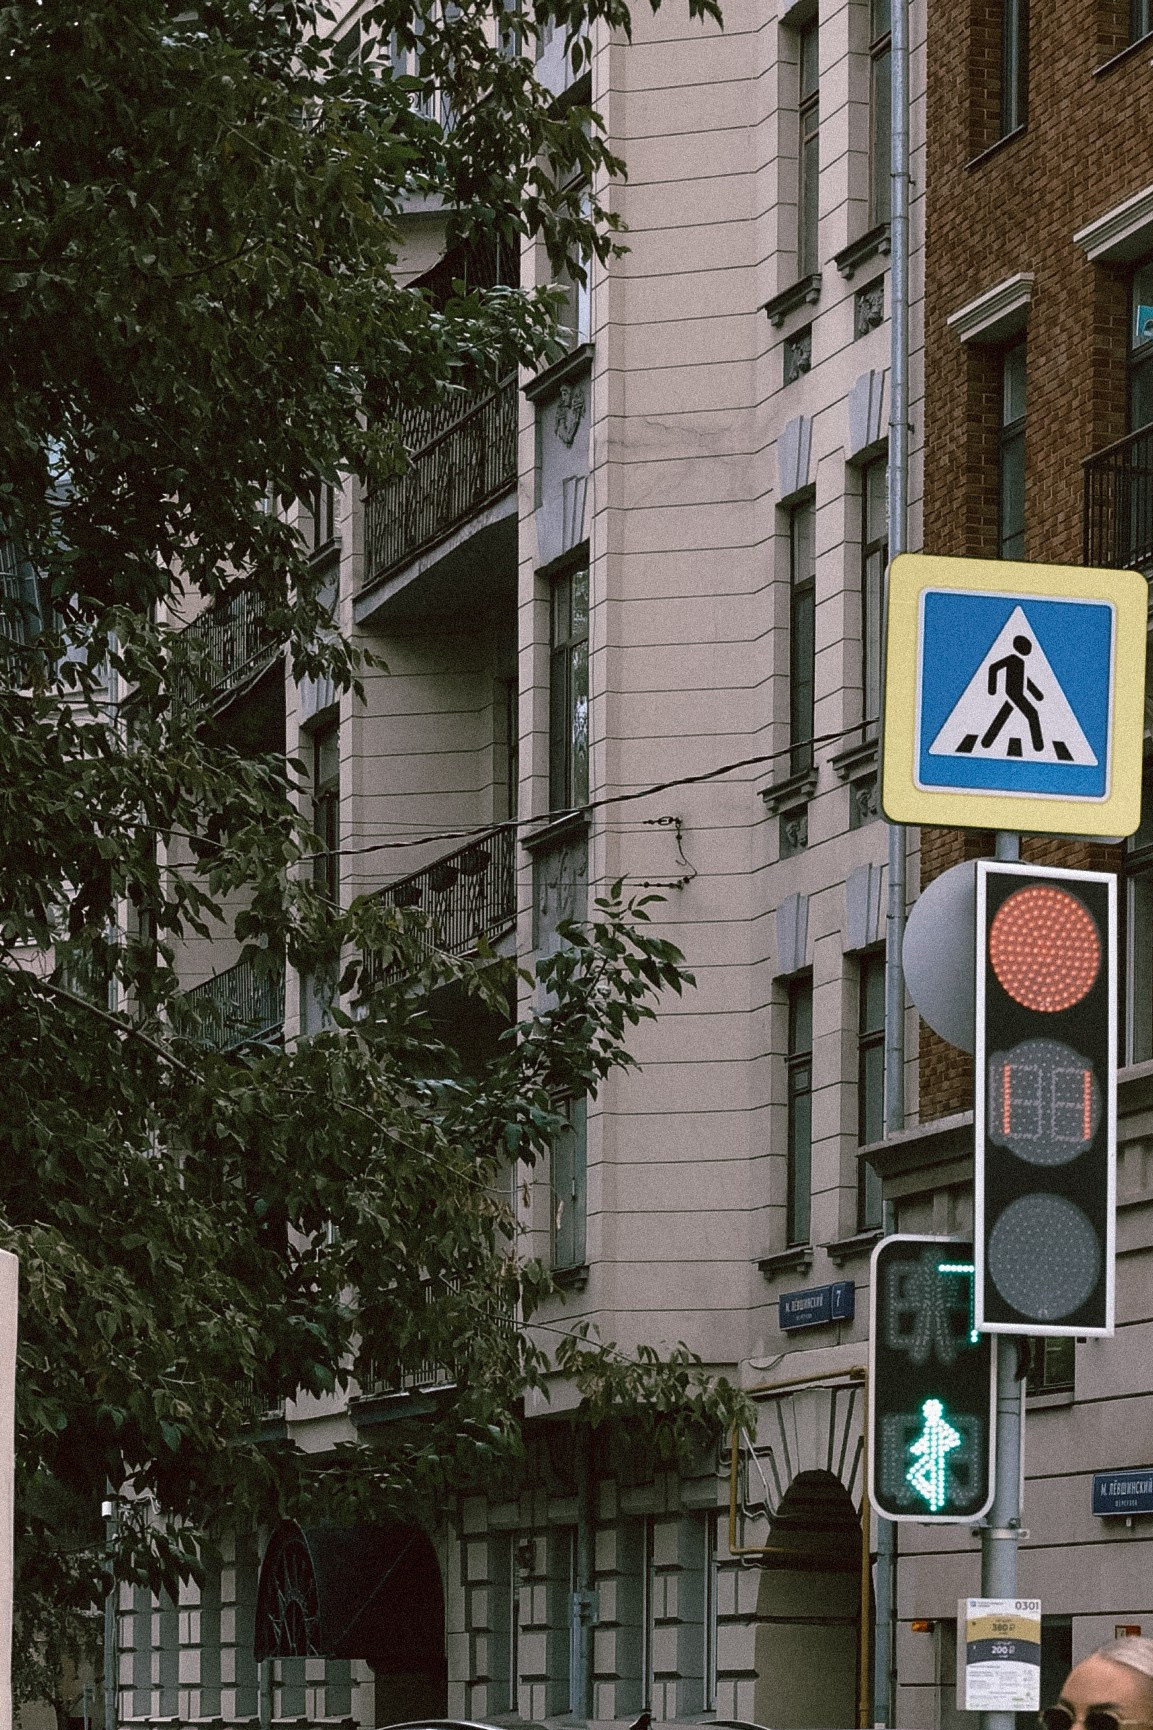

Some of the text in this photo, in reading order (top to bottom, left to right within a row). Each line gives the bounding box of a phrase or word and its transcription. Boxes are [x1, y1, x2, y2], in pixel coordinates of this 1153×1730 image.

[837, 1290, 842, 1308] 7
[1015, 1601, 1039, 1610] 0301
[992, 1645, 1008, 1654] 200
